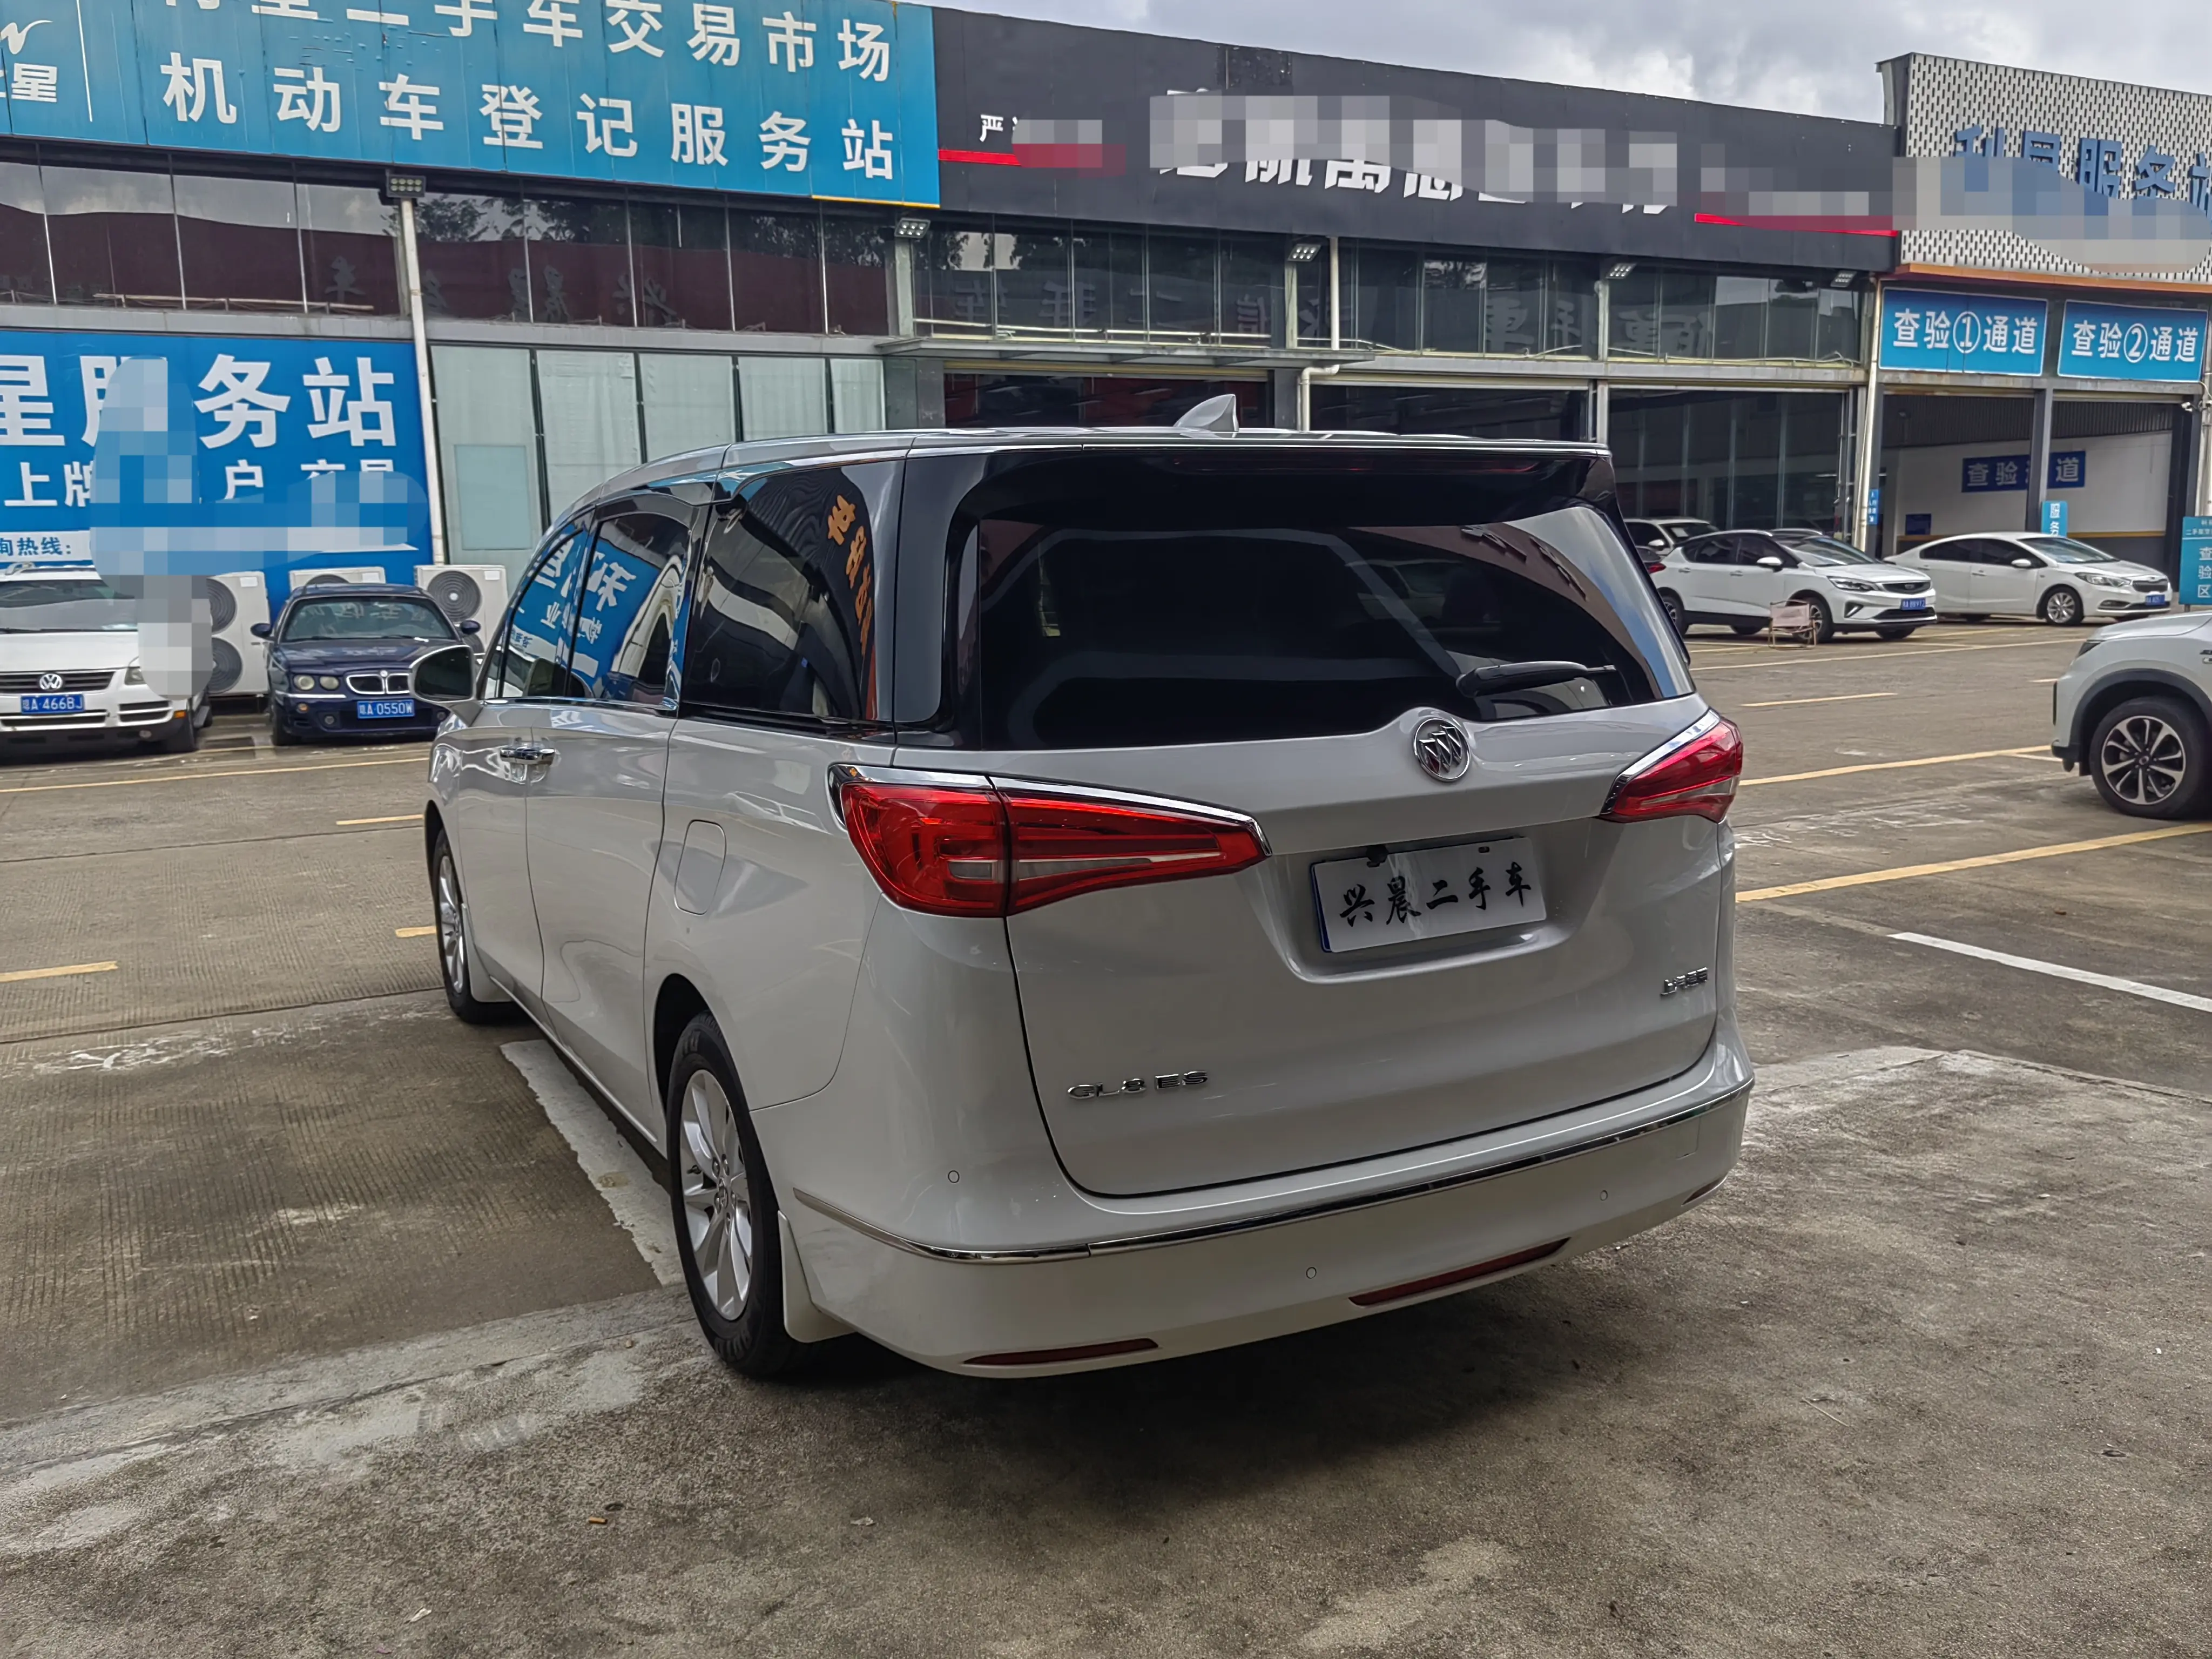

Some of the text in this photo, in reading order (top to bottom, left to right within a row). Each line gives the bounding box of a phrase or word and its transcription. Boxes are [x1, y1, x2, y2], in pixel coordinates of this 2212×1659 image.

[0, 63, 57, 103] 星
[160, 52, 894, 180] 机动车登记服务站
[1967, 457, 2079, 487] 查验道
[1339, 861, 1532, 927] 兴晨二手车
[1067, 1070, 1209, 1100] GL8 ES
